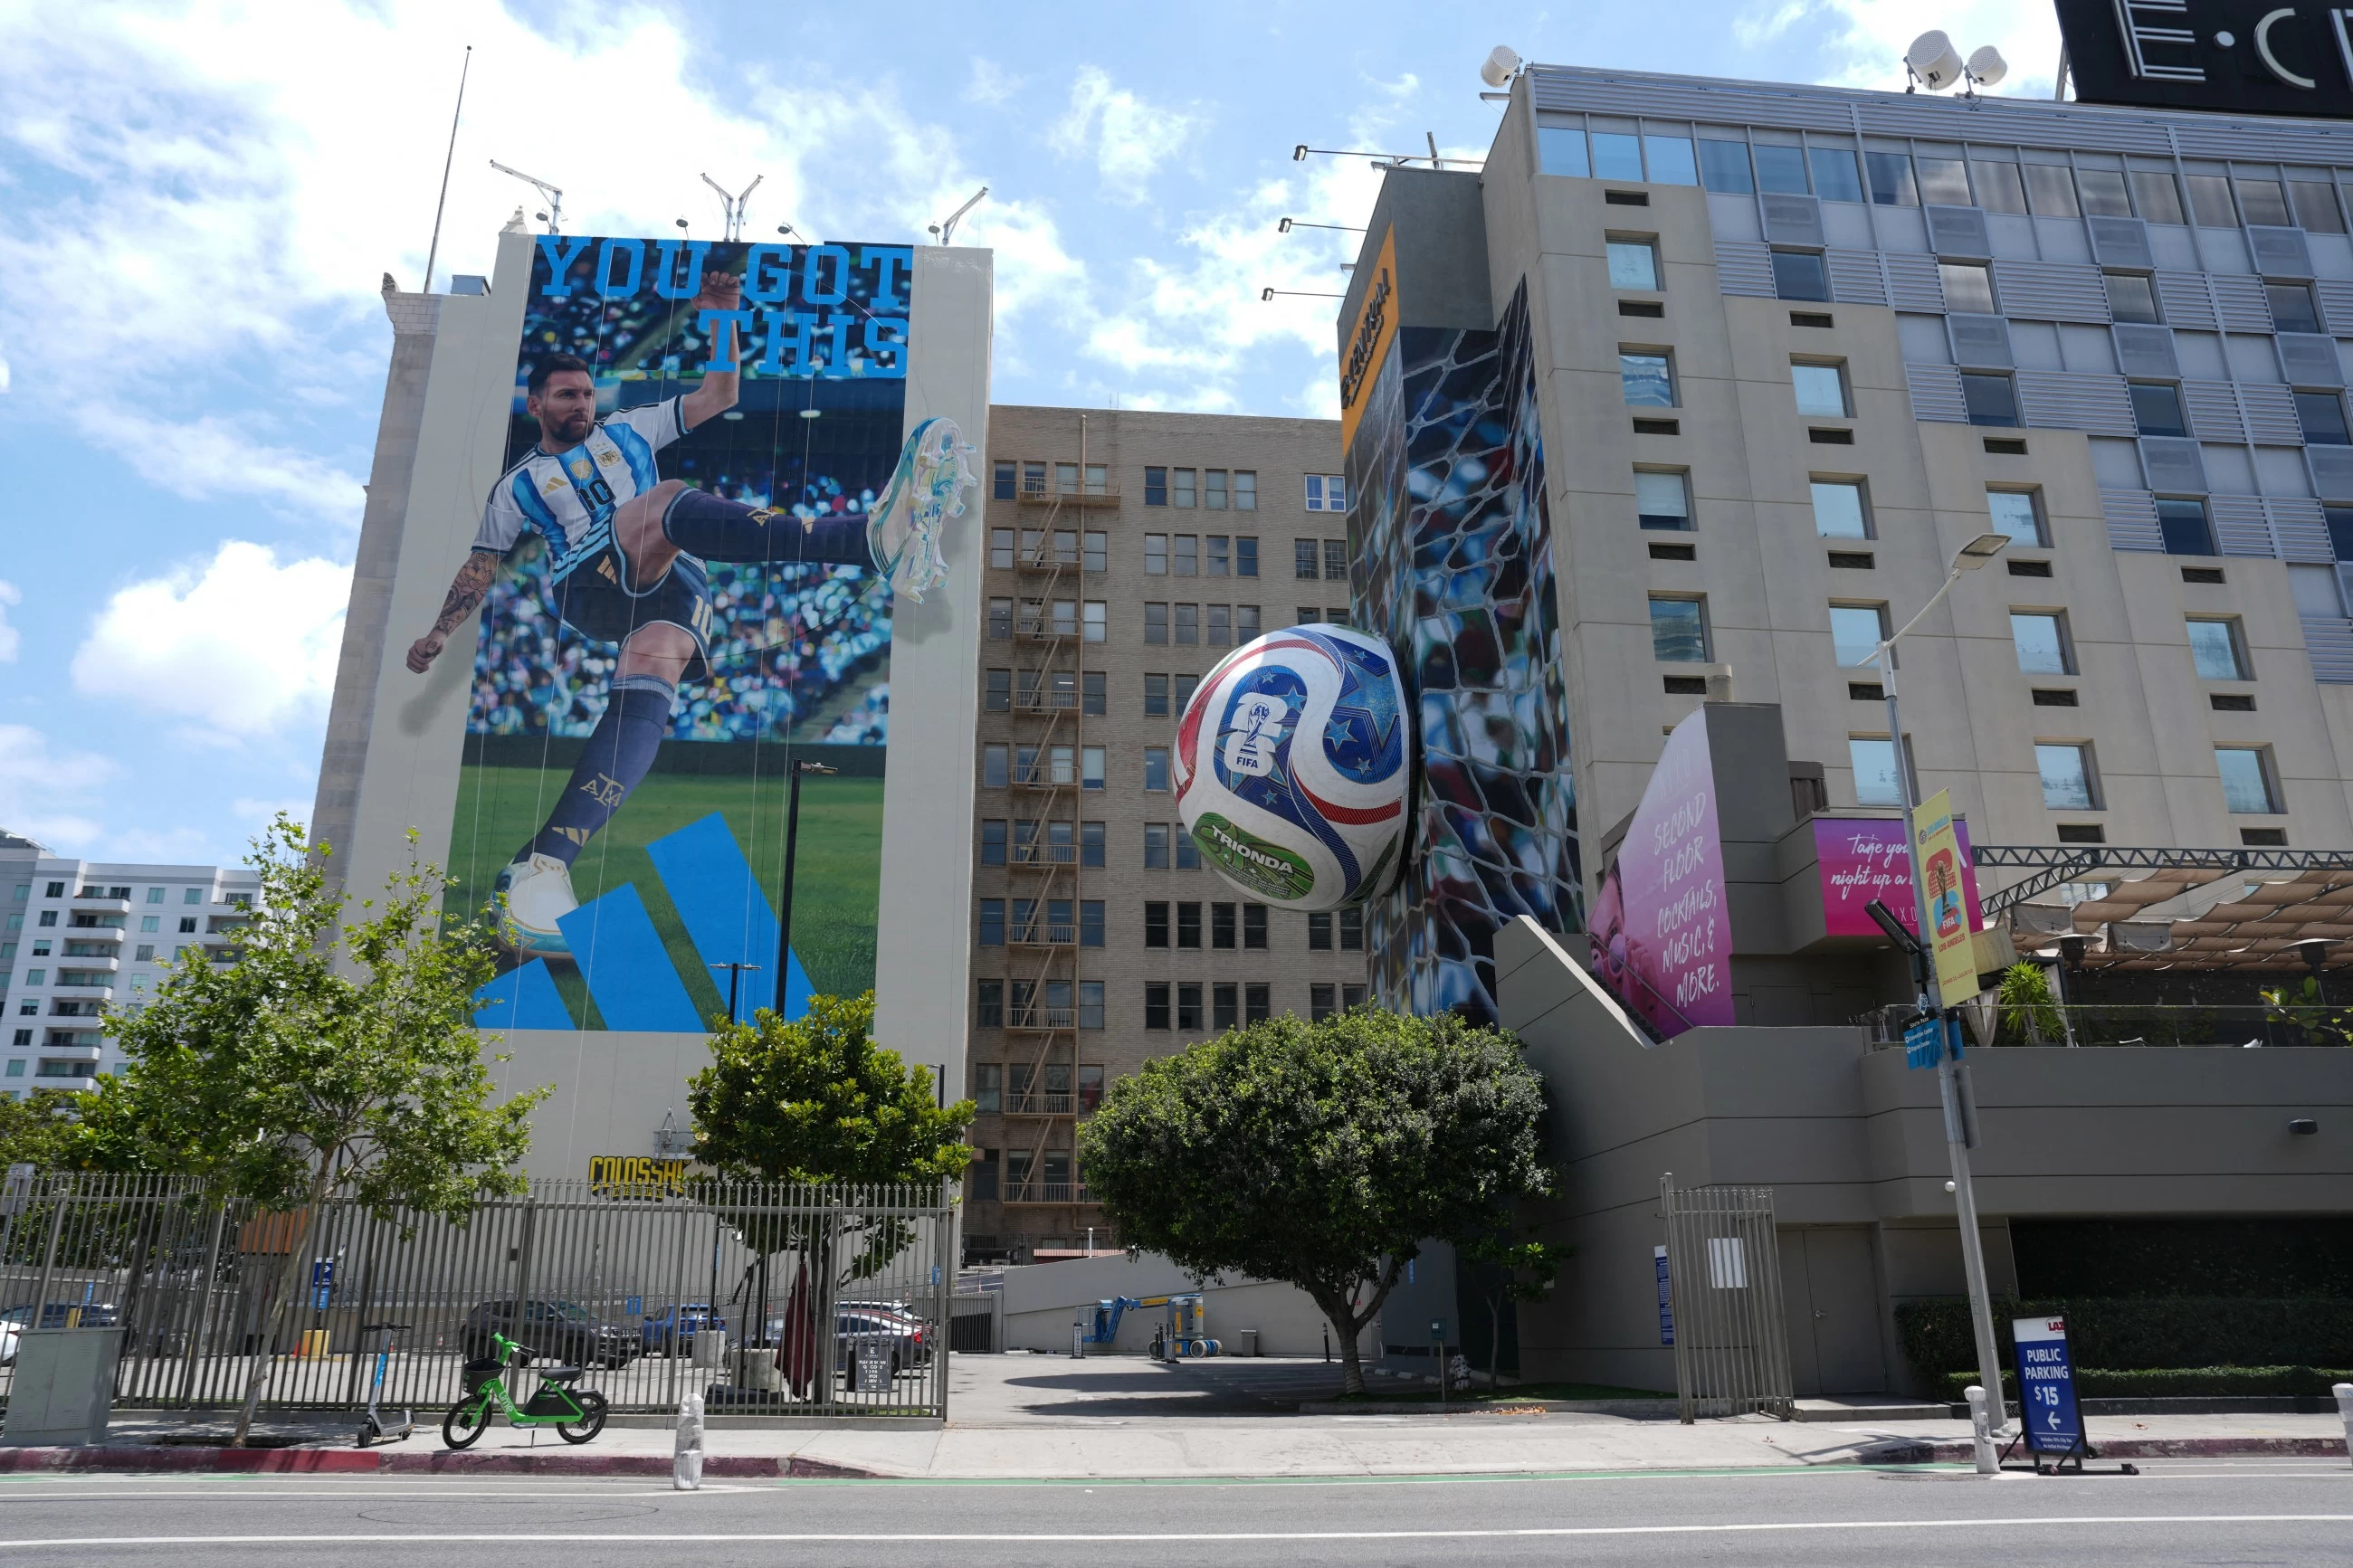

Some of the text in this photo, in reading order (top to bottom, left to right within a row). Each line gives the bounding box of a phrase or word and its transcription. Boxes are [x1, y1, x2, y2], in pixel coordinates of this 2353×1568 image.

[536, 234, 913, 309] YOU GOT
[697, 309, 910, 379] THIS
[576, 478, 616, 513] 10
[691, 594, 713, 645] 10
[1236, 756, 1258, 769] FIFA
[579, 772, 624, 807] AFA
[1654, 792, 1706, 856] SECOND
[1212, 824, 1294, 874] TRIONDA
[1663, 836, 1704, 892] FLOOR
[1847, 833, 1910, 869] Take you
[1831, 865, 1872, 900] night
[1872, 873, 1891, 898] up
[1894, 874, 1907, 885] a
[1657, 879, 1717, 939] COCKTAILS,
[1942, 916, 1956, 929] FIFA
[1939, 933, 1966, 953] LOS ANGELES
[1677, 963, 1720, 1008] MORE.
[589, 1156, 685, 1194] COLOSSAL
[2024, 1365, 2069, 1380] PARKING
[2026, 1348, 2062, 1363] PUBLIC
[499, 1390, 513, 1413] Lime
